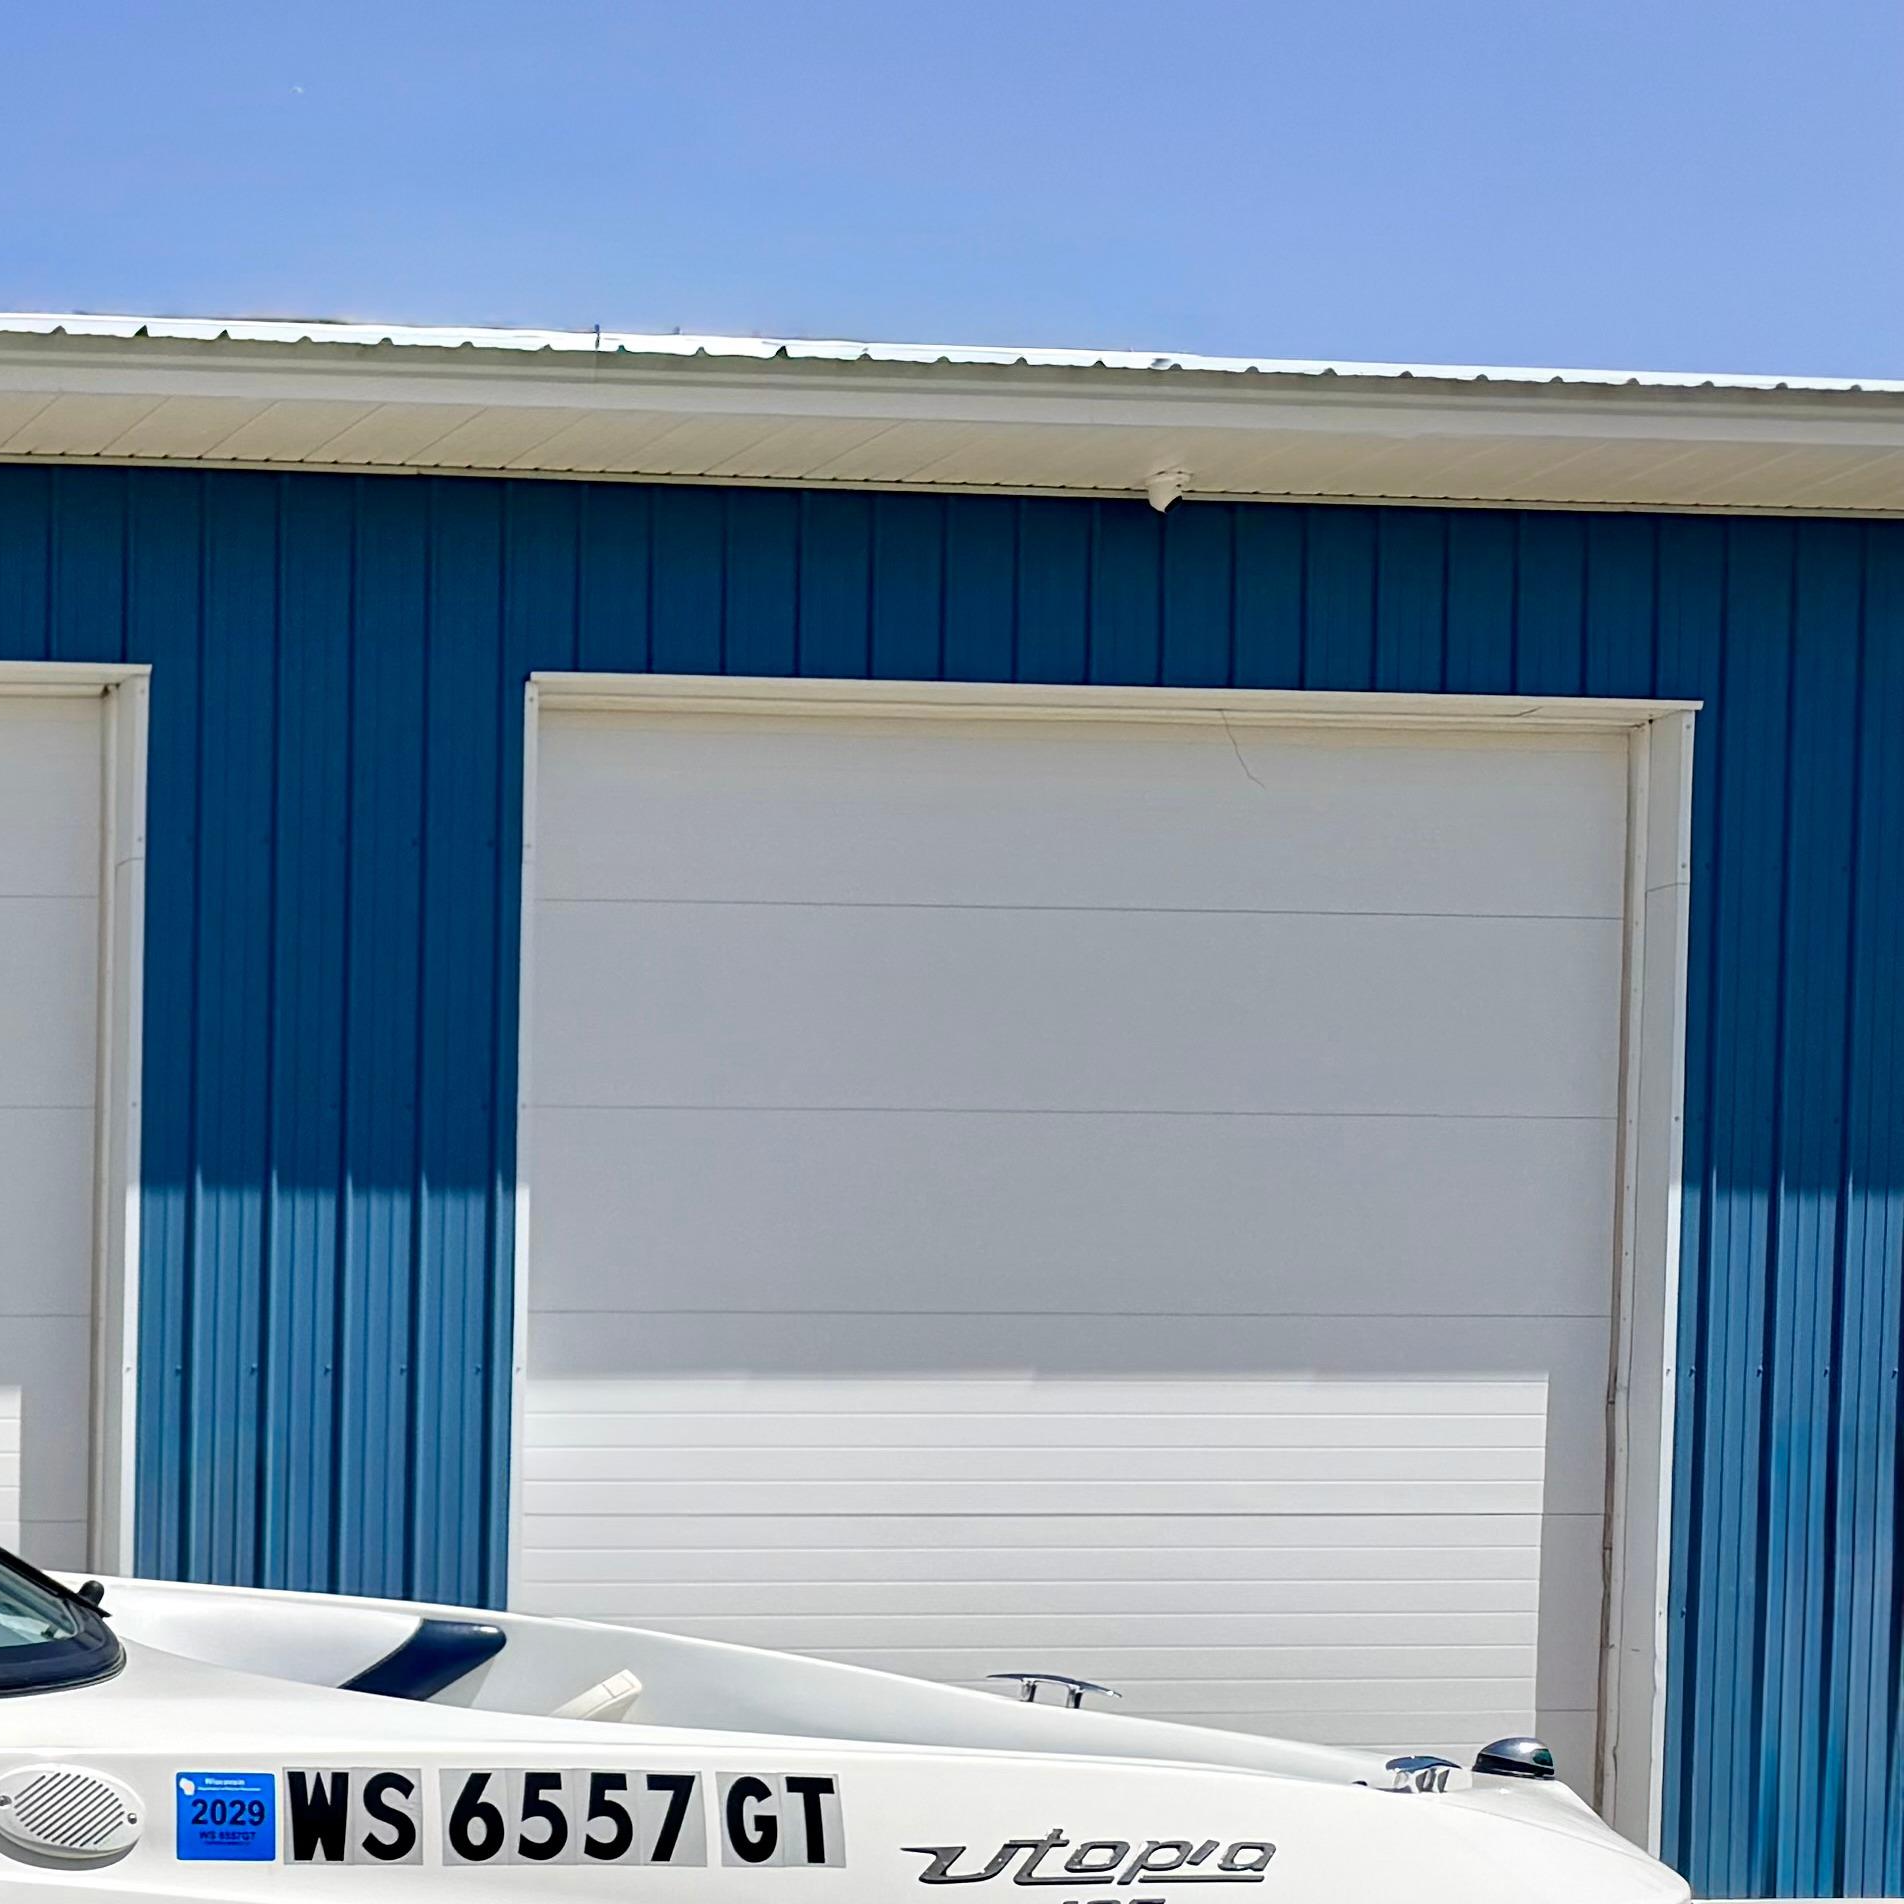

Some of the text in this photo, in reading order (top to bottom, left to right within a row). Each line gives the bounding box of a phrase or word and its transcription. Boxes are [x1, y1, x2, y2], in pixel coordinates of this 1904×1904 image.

[191, 1799, 266, 1826] 2029
[288, 1772, 835, 1864] WS 6557 GT
